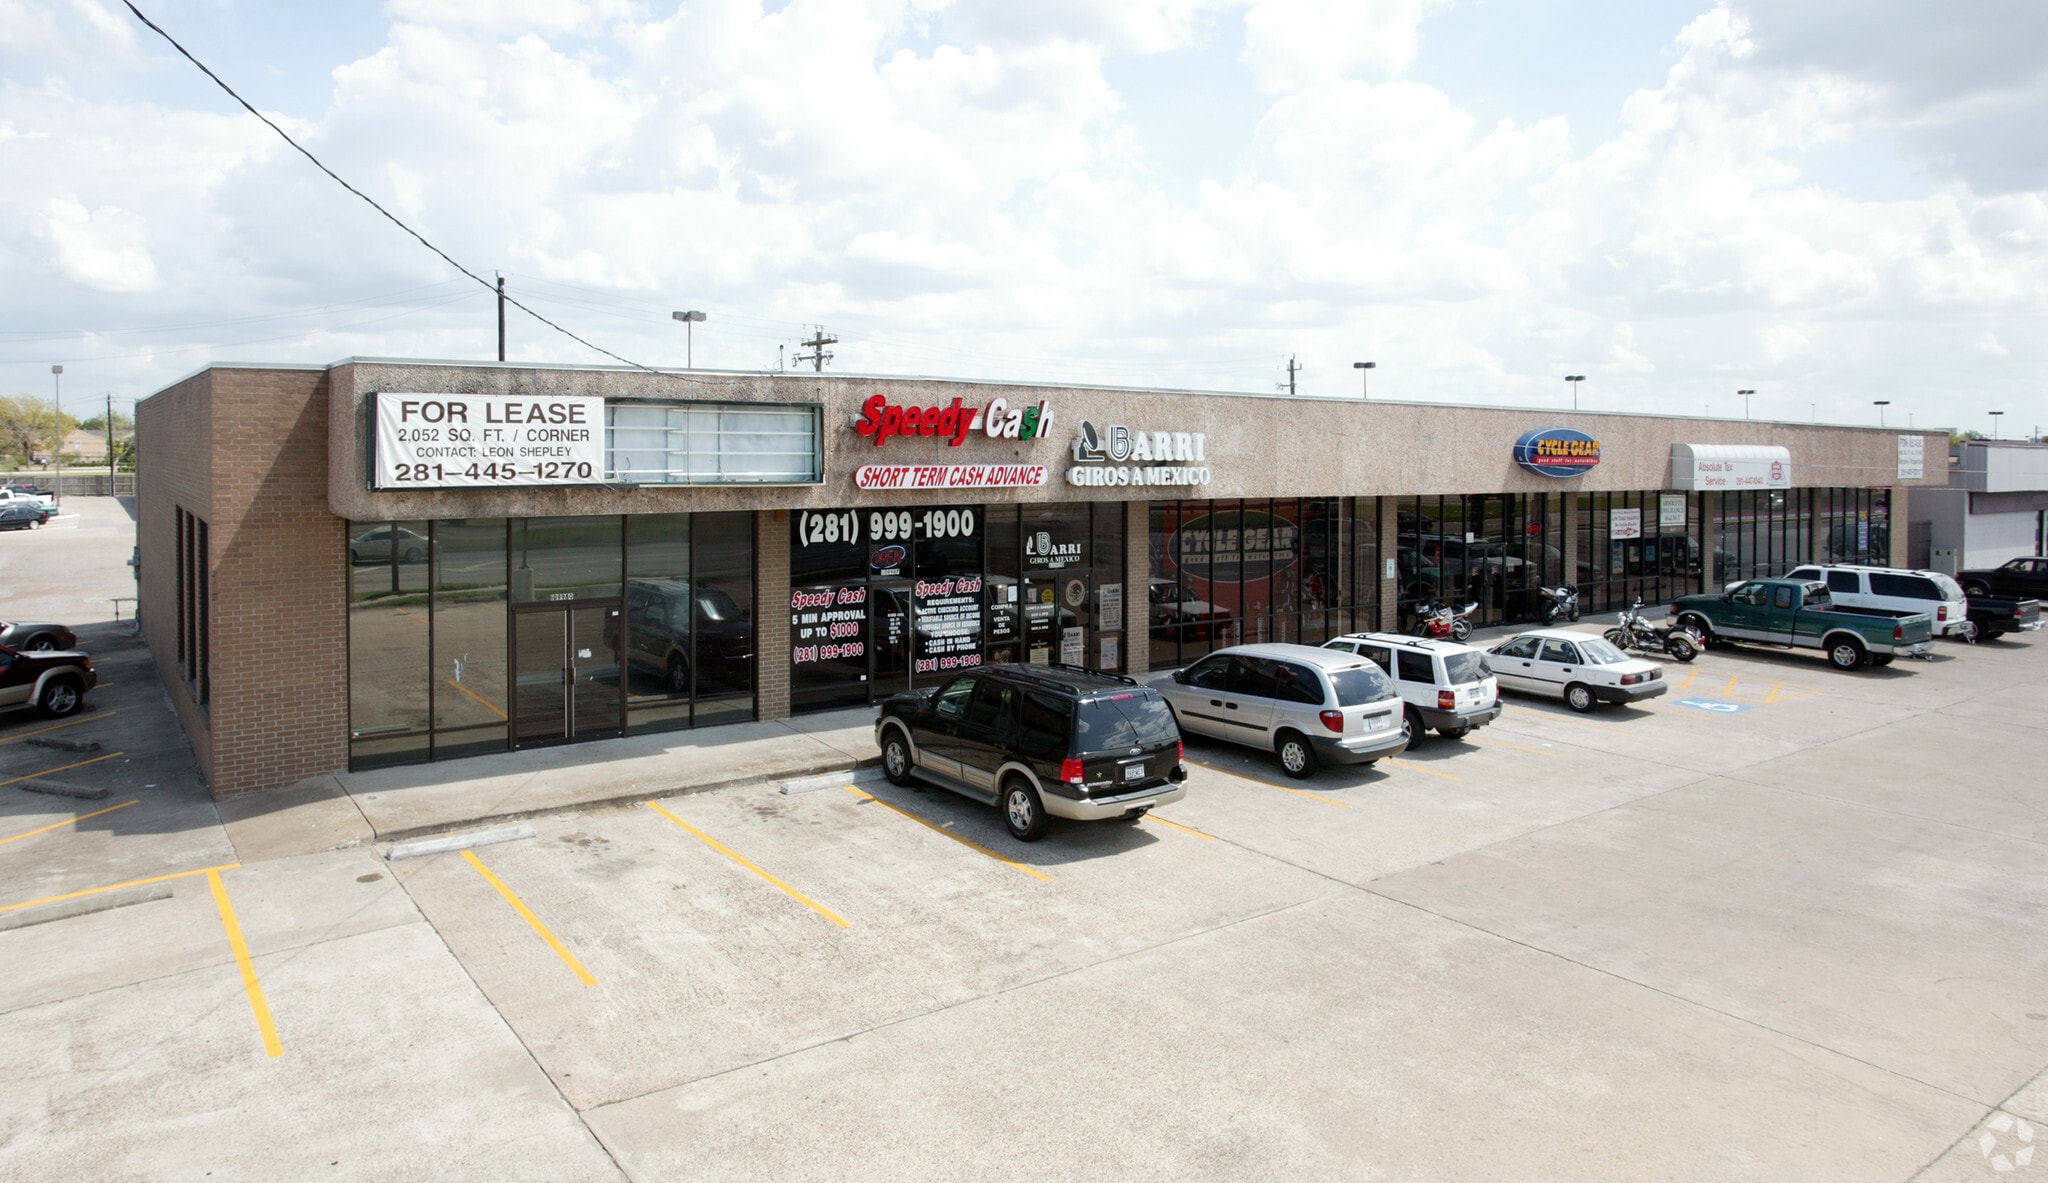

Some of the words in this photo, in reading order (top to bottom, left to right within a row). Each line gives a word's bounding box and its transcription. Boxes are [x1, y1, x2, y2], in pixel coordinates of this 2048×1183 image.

[401, 401, 468, 423] FOR
[486, 403, 586, 424] LEASE
[856, 394, 978, 447] Speedy
[398, 428, 439, 443] 2,052
[448, 428, 475, 442] SQ.
[484, 429, 504, 442] FT.
[527, 429, 590, 442] CORNER
[1106, 425, 1206, 461] BARRI
[416, 447, 476, 458] CONTACT:
[482, 447, 514, 457] LEON
[520, 447, 572, 457] SHEPLEY
[1538, 440, 1569, 456] CYCLE
[1571, 440, 1599, 456] GEAR
[861, 467, 910, 487] SHORT
[911, 467, 948, 486] TERM
[950, 467, 986, 486] CASH
[986, 466, 1043, 485] ADVANCE
[1071, 466, 1129, 486] GIROS
[1131, 466, 1144, 486] A
[1144, 466, 1210, 486] MEXICO
[1698, 462, 1722, 471] Absolute
[800, 509, 859, 547] (281)
[1036, 532, 1081, 556] BARRI
[871, 550, 903, 566] OPEN
[916, 579, 954, 598] Speedy
[956, 577, 981, 593] Cash
[791, 589, 835, 610] Speedy
[838, 587, 866, 604] Cash
[792, 615, 798, 625] 5
[802, 613, 818, 624] MIN
[821, 610, 866, 622] APPROVAL
[801, 628, 812, 638] UP
[816, 627, 827, 637] TO
[830, 622, 858, 640] $1000
[794, 644, 818, 664] (281)
[820, 642, 864, 659] 999-1900
[929, 646, 945, 654] CASH
[915, 657, 938, 673] (281)
[940, 654, 981, 669] 999-1900
